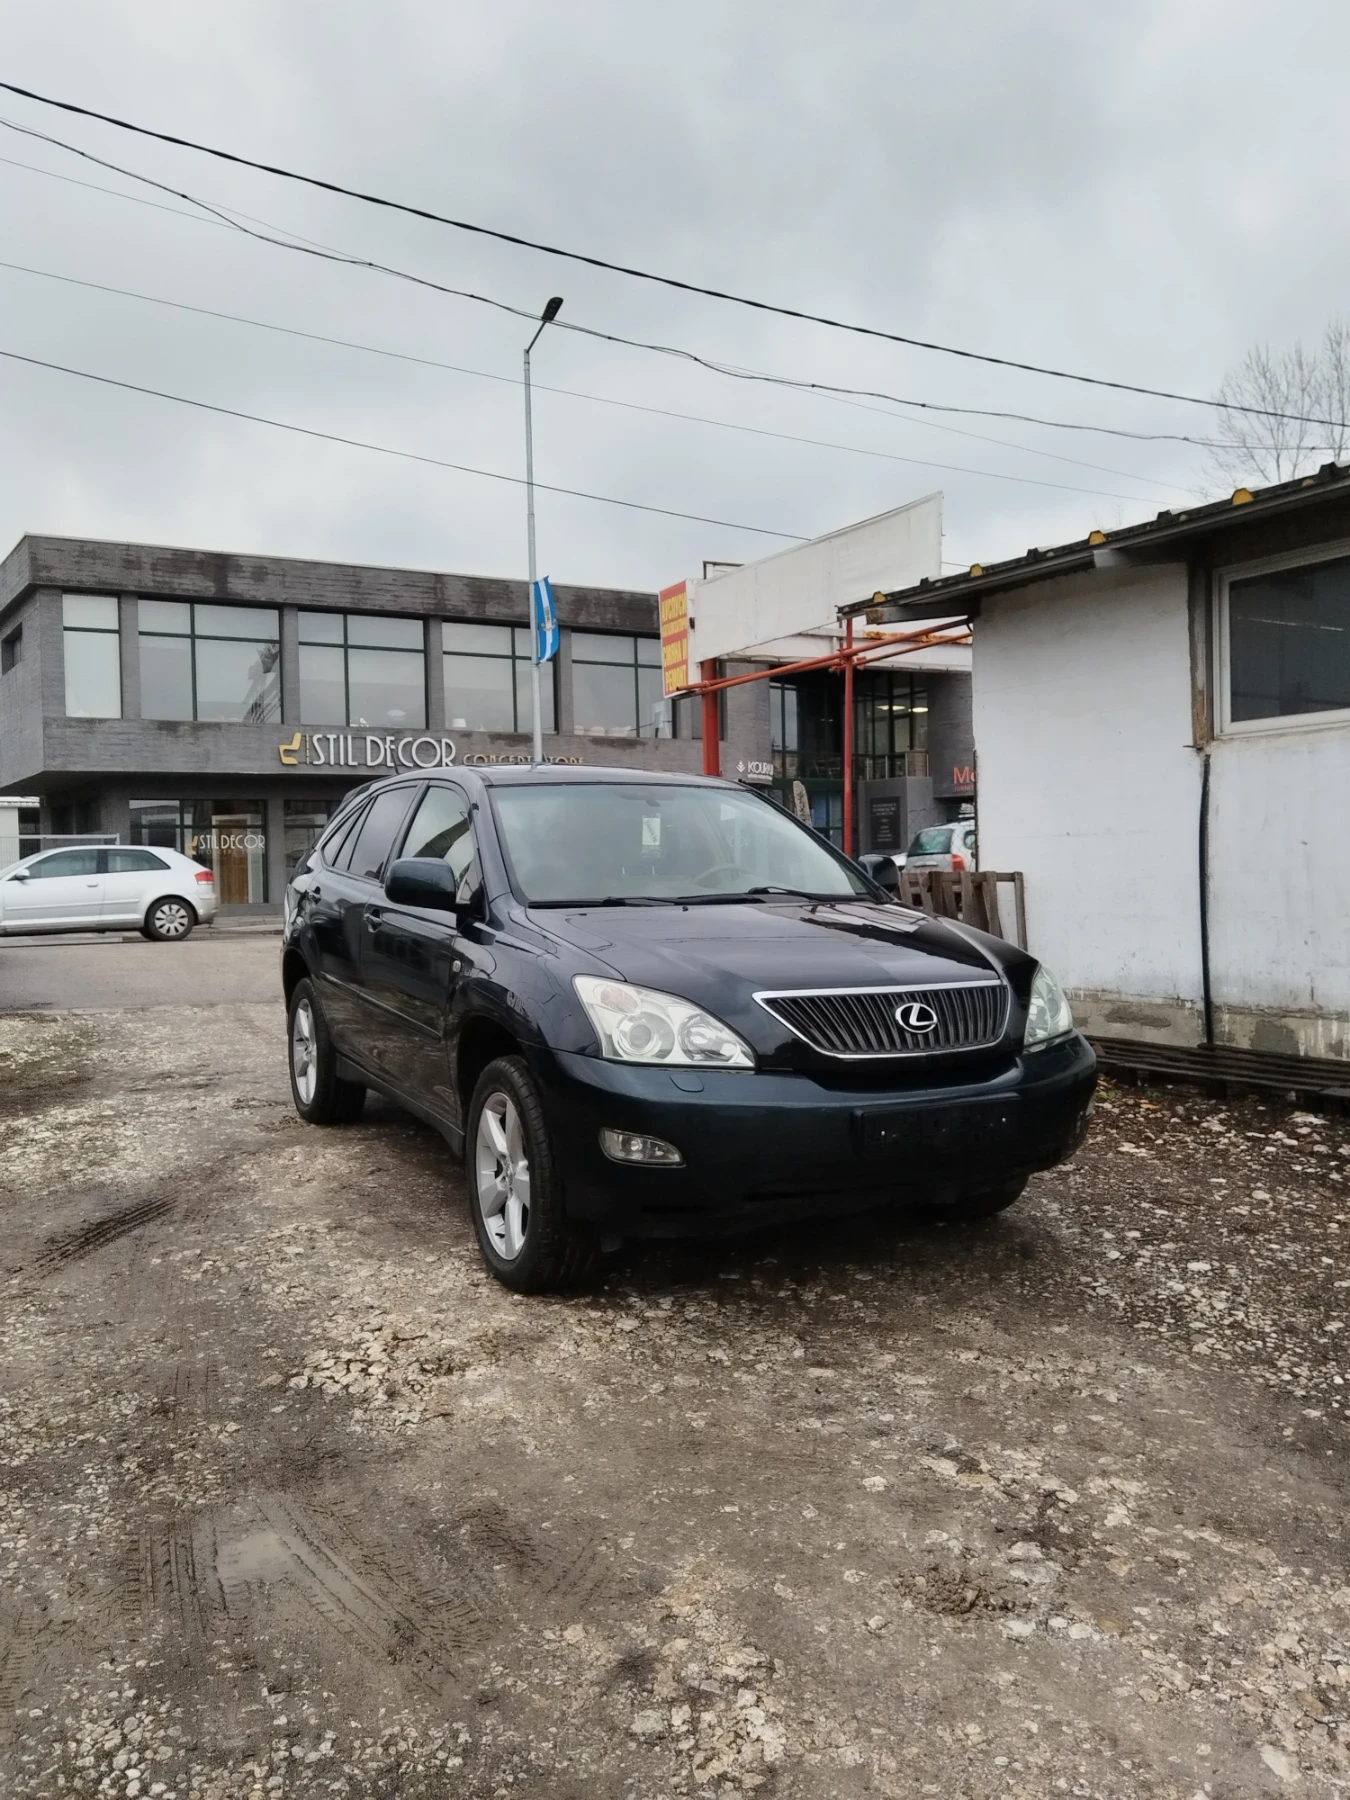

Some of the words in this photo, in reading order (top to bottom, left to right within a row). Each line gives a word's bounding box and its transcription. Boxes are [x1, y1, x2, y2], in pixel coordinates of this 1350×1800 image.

[312, 734, 359, 766] STIL
[365, 735, 457, 768] DECOR
[199, 834, 219, 849] STIL
[220, 834, 266, 849] DECOR
